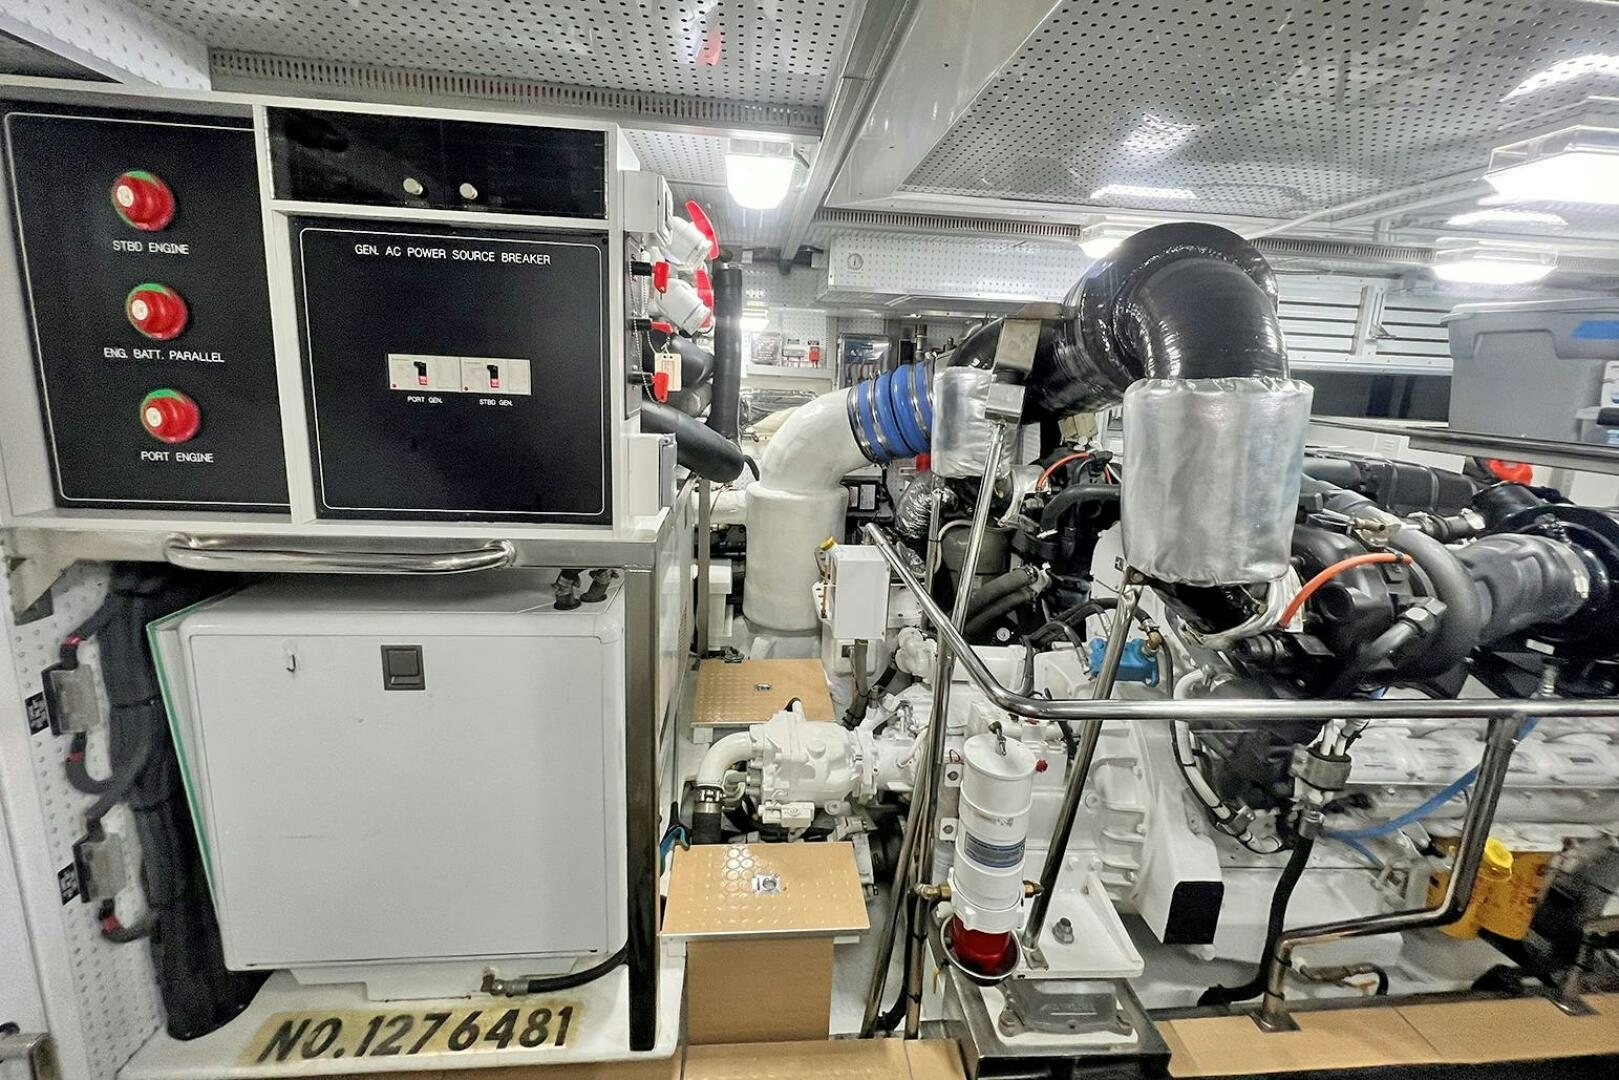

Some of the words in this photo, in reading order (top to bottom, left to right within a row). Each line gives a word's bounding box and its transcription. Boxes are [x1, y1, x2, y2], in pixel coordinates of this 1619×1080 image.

[112, 239, 143, 253] STBD
[148, 241, 190, 256] ENGINE
[354, 244, 379, 256] GEN.
[384, 246, 402, 257] AC
[407, 247, 447, 259] POWER
[451, 249, 496, 263] SOURCE
[501, 252, 552, 265] BREAKER
[103, 347, 129, 359] ENG.
[133, 348, 165, 360] BATT.
[169, 350, 225, 363] PARALLEL
[406, 395, 426, 403] PORT
[140, 450, 170, 462] PORT
[175, 451, 214, 463] ENGINE
